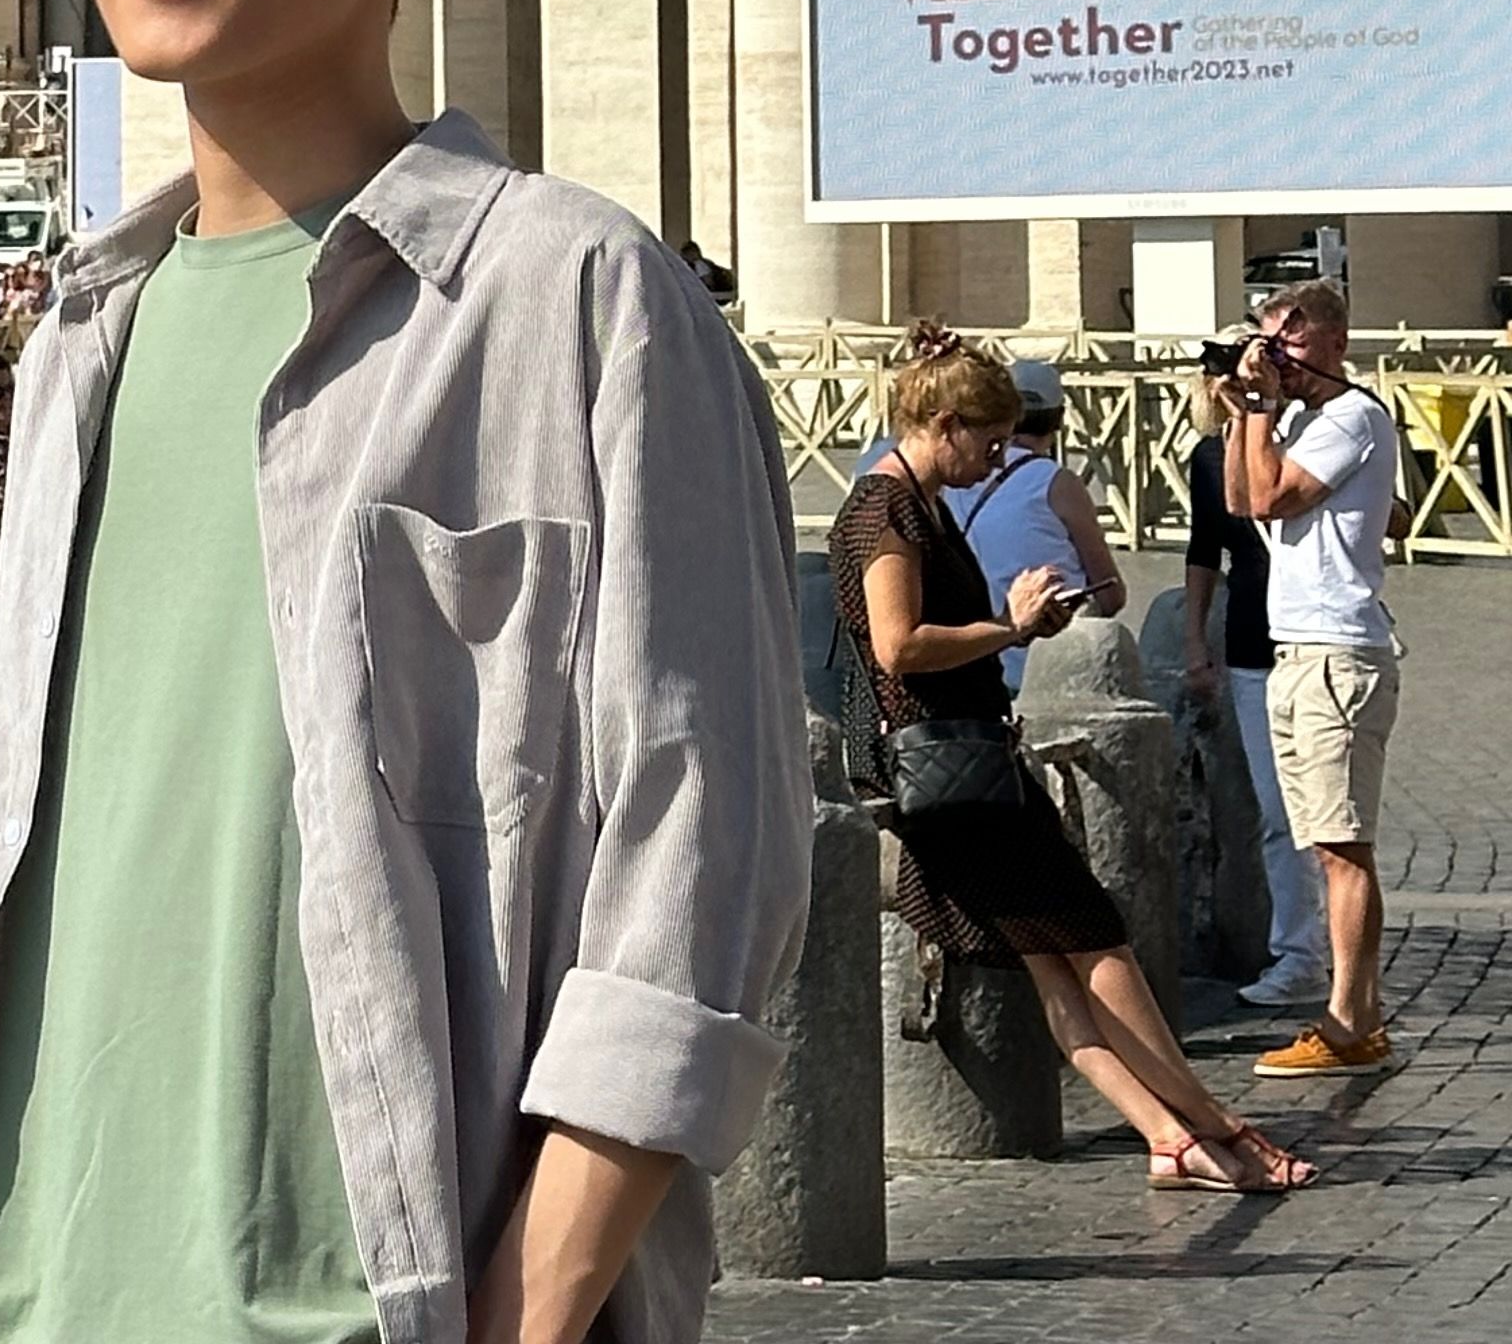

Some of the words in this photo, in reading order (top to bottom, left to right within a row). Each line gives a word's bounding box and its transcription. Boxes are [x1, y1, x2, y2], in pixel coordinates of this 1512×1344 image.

[1192, 15, 1303, 34] Gathering
[917, 6, 1183, 74] Together
[1193, 32, 1216, 51] of
[1223, 31, 1257, 50] the
[1264, 29, 1337, 51] People
[1343, 27, 1366, 47] of
[1373, 27, 1420, 46] God
[1030, 59, 1294, 88] www.together2023.net
